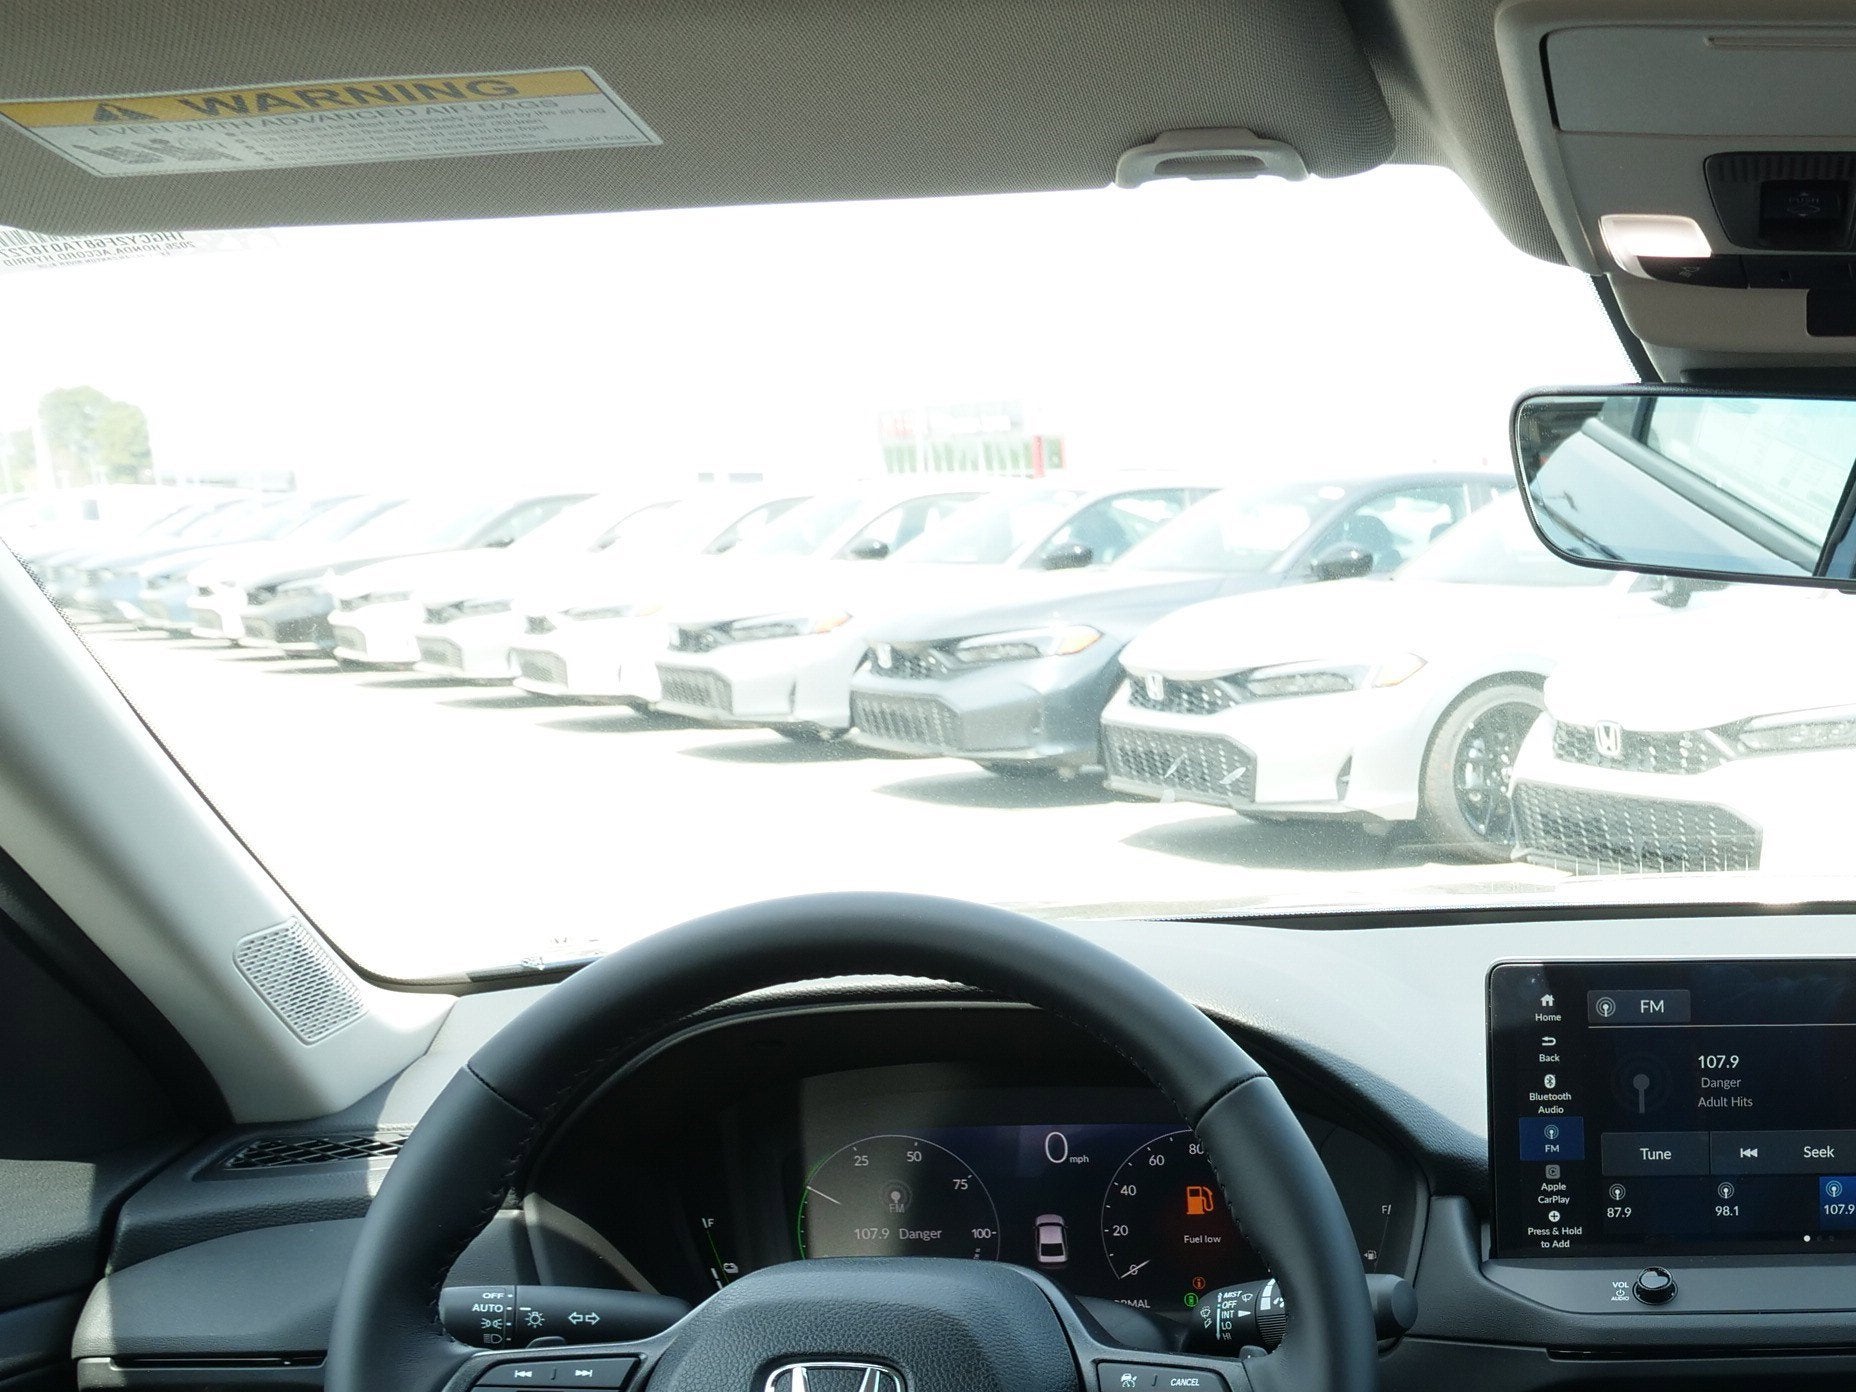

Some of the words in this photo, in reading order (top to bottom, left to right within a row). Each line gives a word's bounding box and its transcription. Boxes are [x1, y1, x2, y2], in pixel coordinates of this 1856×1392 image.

[179, 78, 520, 117] WARNING
[262, 106, 416, 129] ADVANCED
[1640, 1000, 1665, 1013] FM
[1535, 1013, 1562, 1022] Home
[1539, 1054, 1560, 1062] Back
[1698, 1055, 1740, 1069] 107.9
[1701, 1077, 1741, 1090] Danger
[1529, 1092, 1572, 1101] Bluetooth
[1698, 1096, 1729, 1108] Adult
[1732, 1096, 1753, 1108] Hits
[1538, 1105, 1564, 1114] Audio
[1045, 1132, 1068, 1163] 0
[1070, 1155, 1089, 1164] mph
[1545, 1145, 1560, 1153] FM
[1803, 1146, 1835, 1158] Seek
[907, 1151, 922, 1162] 50
[1640, 1148, 1672, 1160] Tune
[854, 1156, 869, 1166] 25
[1149, 1155, 1165, 1166] 60
[953, 1180, 968, 1190] 75
[1541, 1182, 1566, 1192] Apple
[1120, 1185, 1137, 1196] 40
[1538, 1196, 1570, 1205] CarPlay
[890, 1204, 904, 1213] FM
[1607, 1207, 1632, 1218] 87.9
[1715, 1205, 1740, 1216] 98.1
[1823, 1204, 1855, 1215] 107.9
[854, 1229, 890, 1240] 107.9
[900, 1229, 942, 1240] Danger
[972, 1229, 991, 1239] 100
[1113, 1225, 1128, 1236] 20
[1528, 1227, 1550, 1235] Press
[1562, 1227, 1582, 1235] Hold
[1184, 1235, 1203, 1243] Fuel
[1205, 1235, 1221, 1243] low
[1552, 1240, 1570, 1248] Add
[472, 1304, 503, 1312] AUTO
[1222, 1310, 1234, 1318] INT
[1222, 1321, 1232, 1330] LO
[1171, 1378, 1199, 1386] CANCEL
